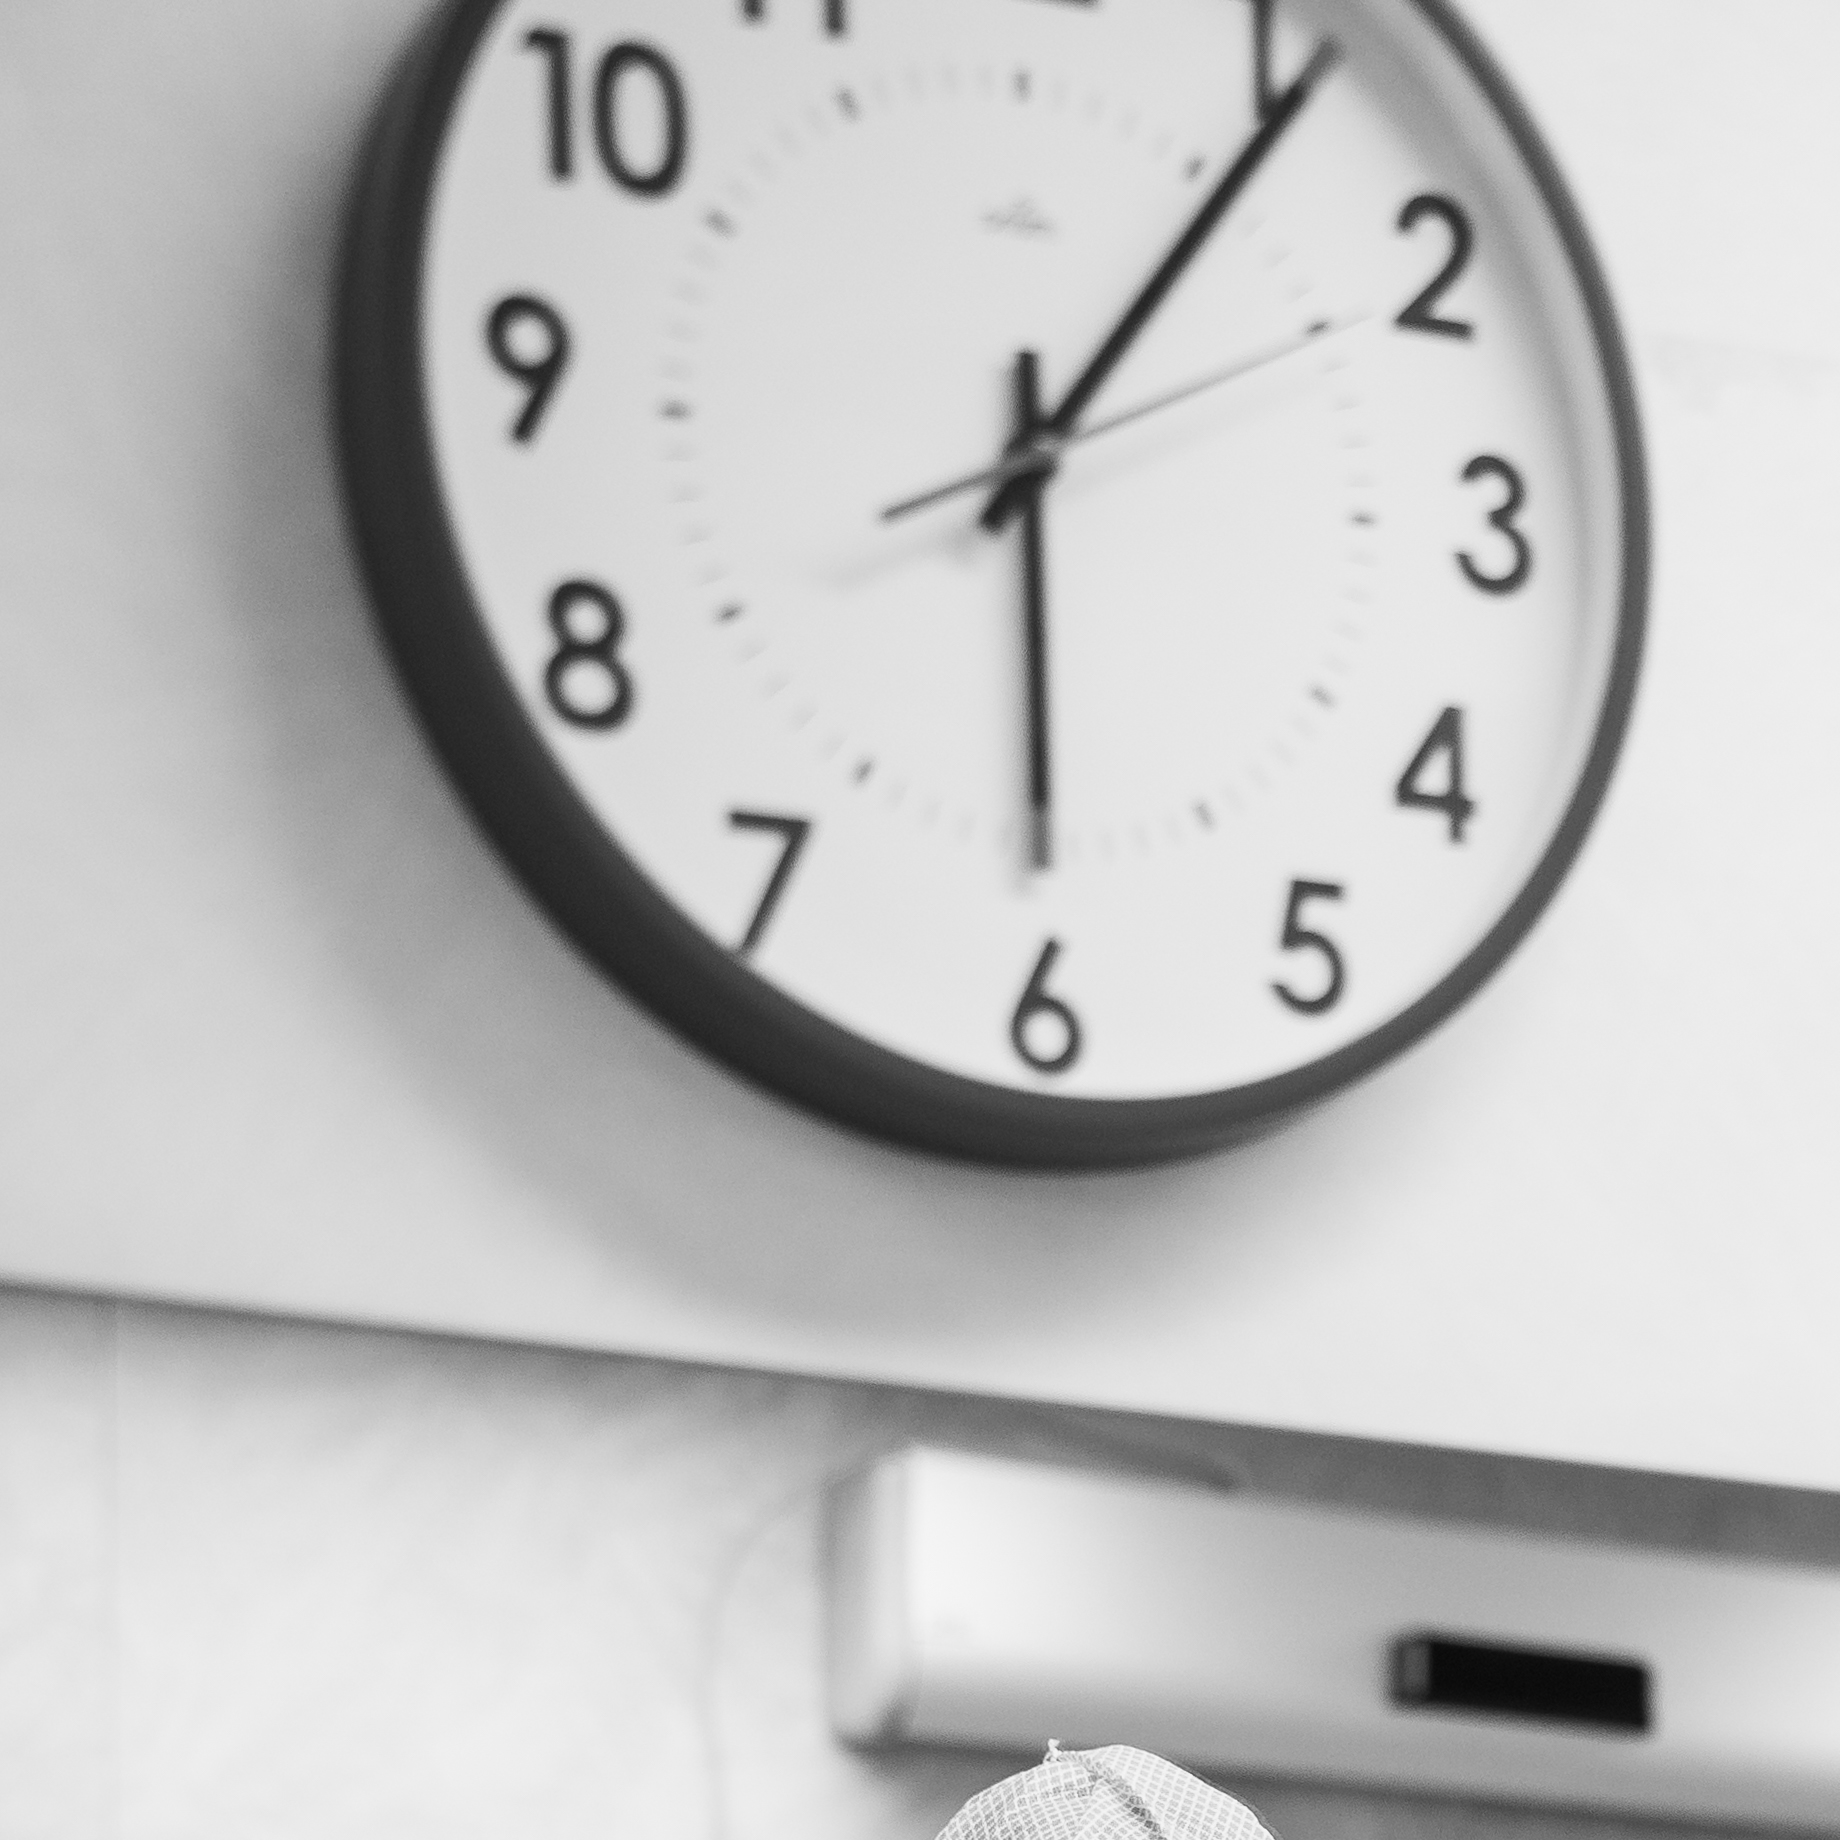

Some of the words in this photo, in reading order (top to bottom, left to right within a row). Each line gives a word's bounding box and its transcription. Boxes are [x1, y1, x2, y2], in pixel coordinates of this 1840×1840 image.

[522, 26, 688, 198] 10
[1394, 191, 1479, 340] 2
[485, 292, 572, 444] 9
[1456, 453, 1534, 597] 3
[543, 578, 635, 732] 8
[1395, 705, 1476, 843] 4
[727, 810, 812, 957] 7
[1273, 878, 1347, 1017] 5
[1009, 938, 1083, 1077] 6
